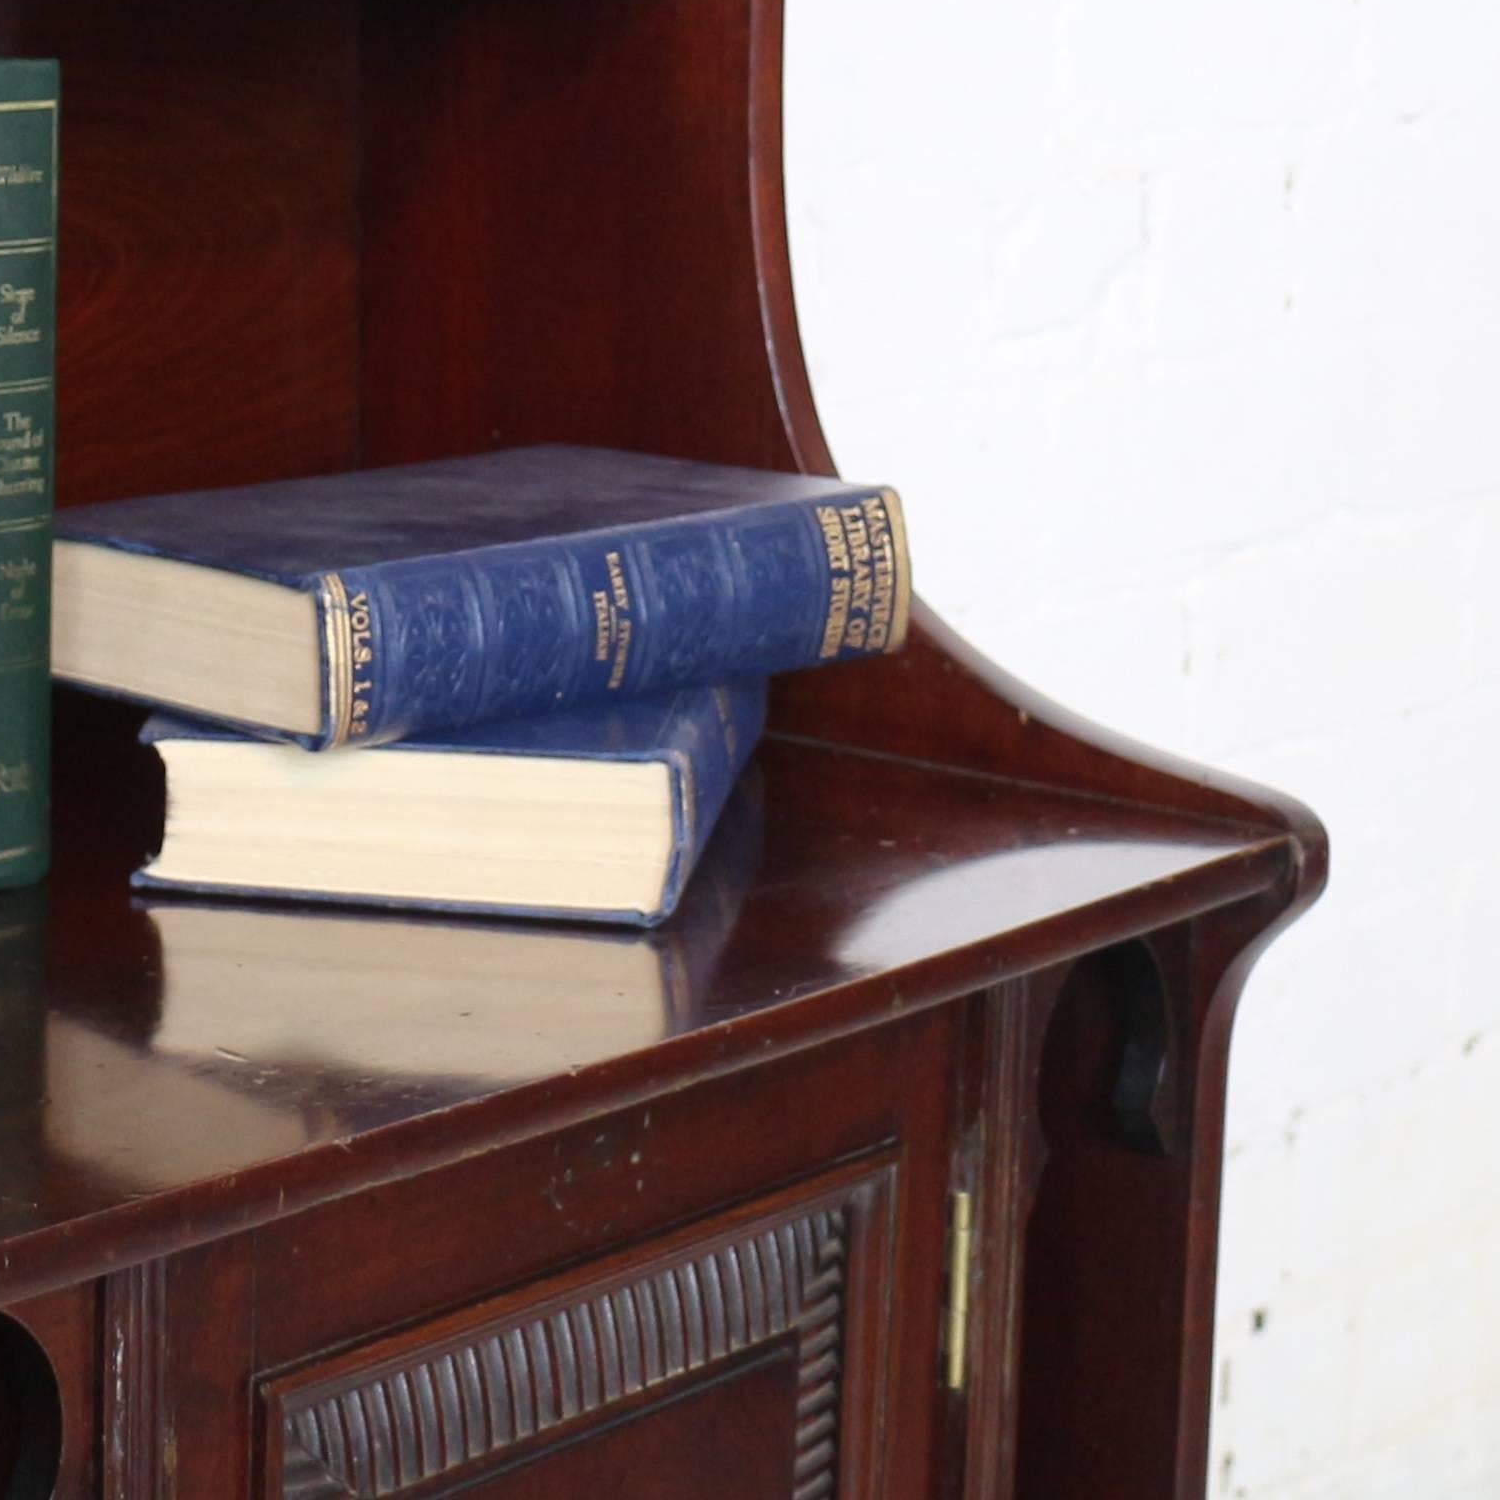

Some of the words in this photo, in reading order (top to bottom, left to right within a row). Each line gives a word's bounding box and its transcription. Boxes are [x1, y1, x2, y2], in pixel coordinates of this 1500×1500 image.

[2, 412, 31, 432] The
[816, 507, 849, 571] SHORT
[840, 507, 873, 611] LIBRARY
[606, 552, 629, 611] EARLY
[351, 591, 372, 670] VOLS.
[820, 579, 849, 658] STORIES
[844, 617, 869, 649] OF
